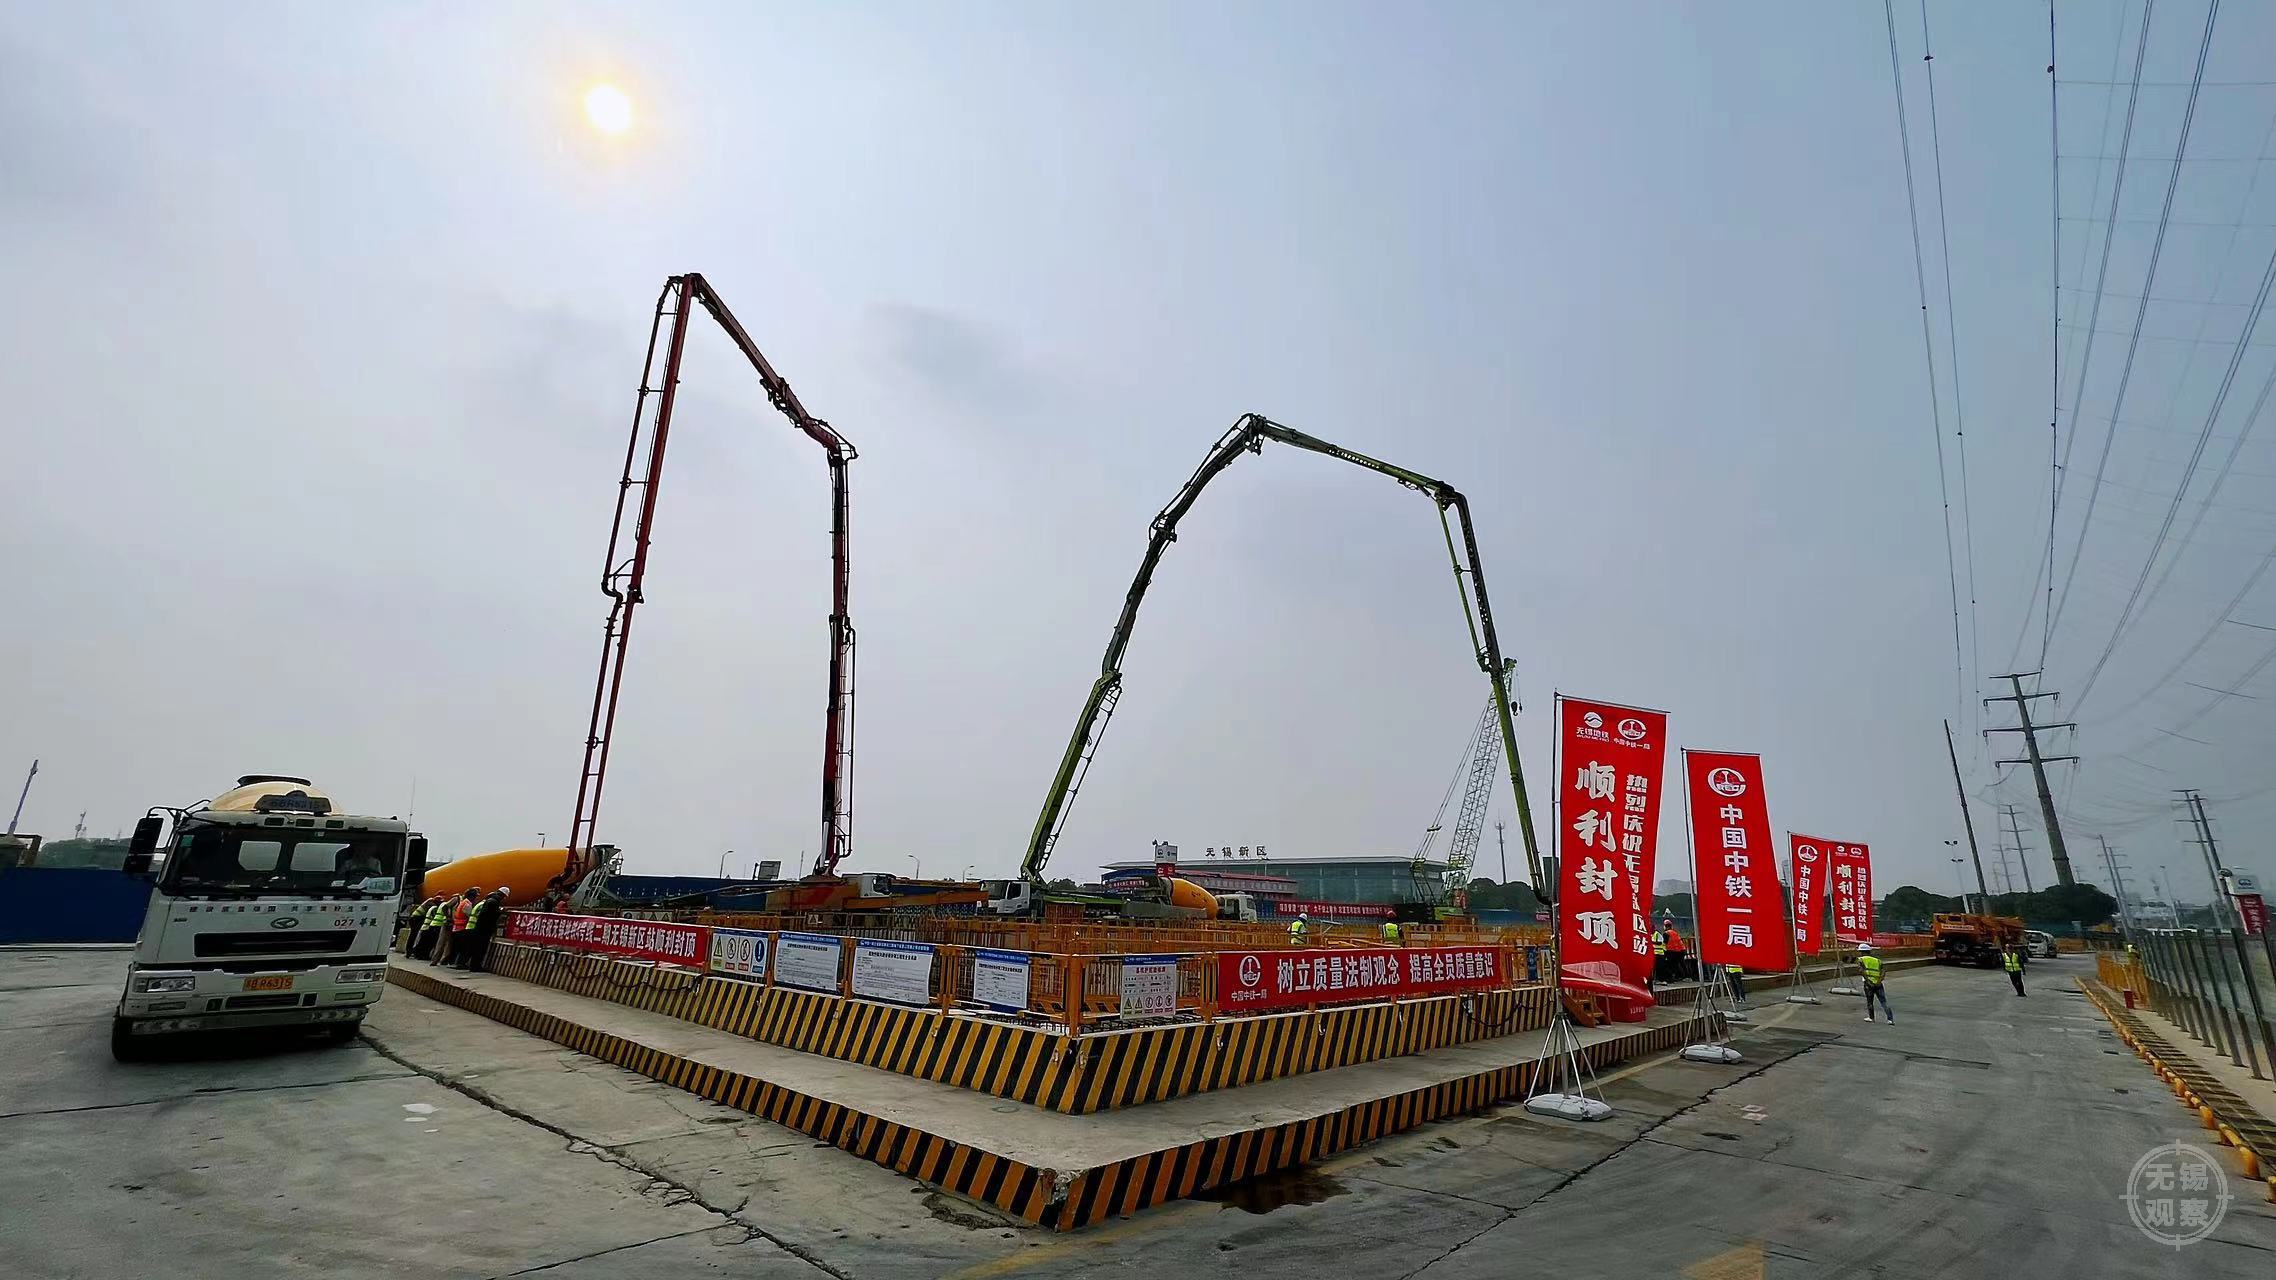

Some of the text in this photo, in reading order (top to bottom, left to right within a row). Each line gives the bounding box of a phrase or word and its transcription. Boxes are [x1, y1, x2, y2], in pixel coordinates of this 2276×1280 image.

[1576, 727, 1609, 738] 无锡地铁
[1205, 845, 1268, 858] 无锡新区
[1573, 760, 1619, 950] 顺利封顶
[1719, 803, 1753, 949] 中国中铁一局
[1836, 863, 1857, 930] 顺利封顶
[333, 918, 355, 928] 027
[1796, 864, 1811, 942] 中国中铁一局
[1277, 951, 1495, 993] 树立质量法制观念 提高全员质量意识
[1231, 988, 1268, 1002] 中国中铁一局
